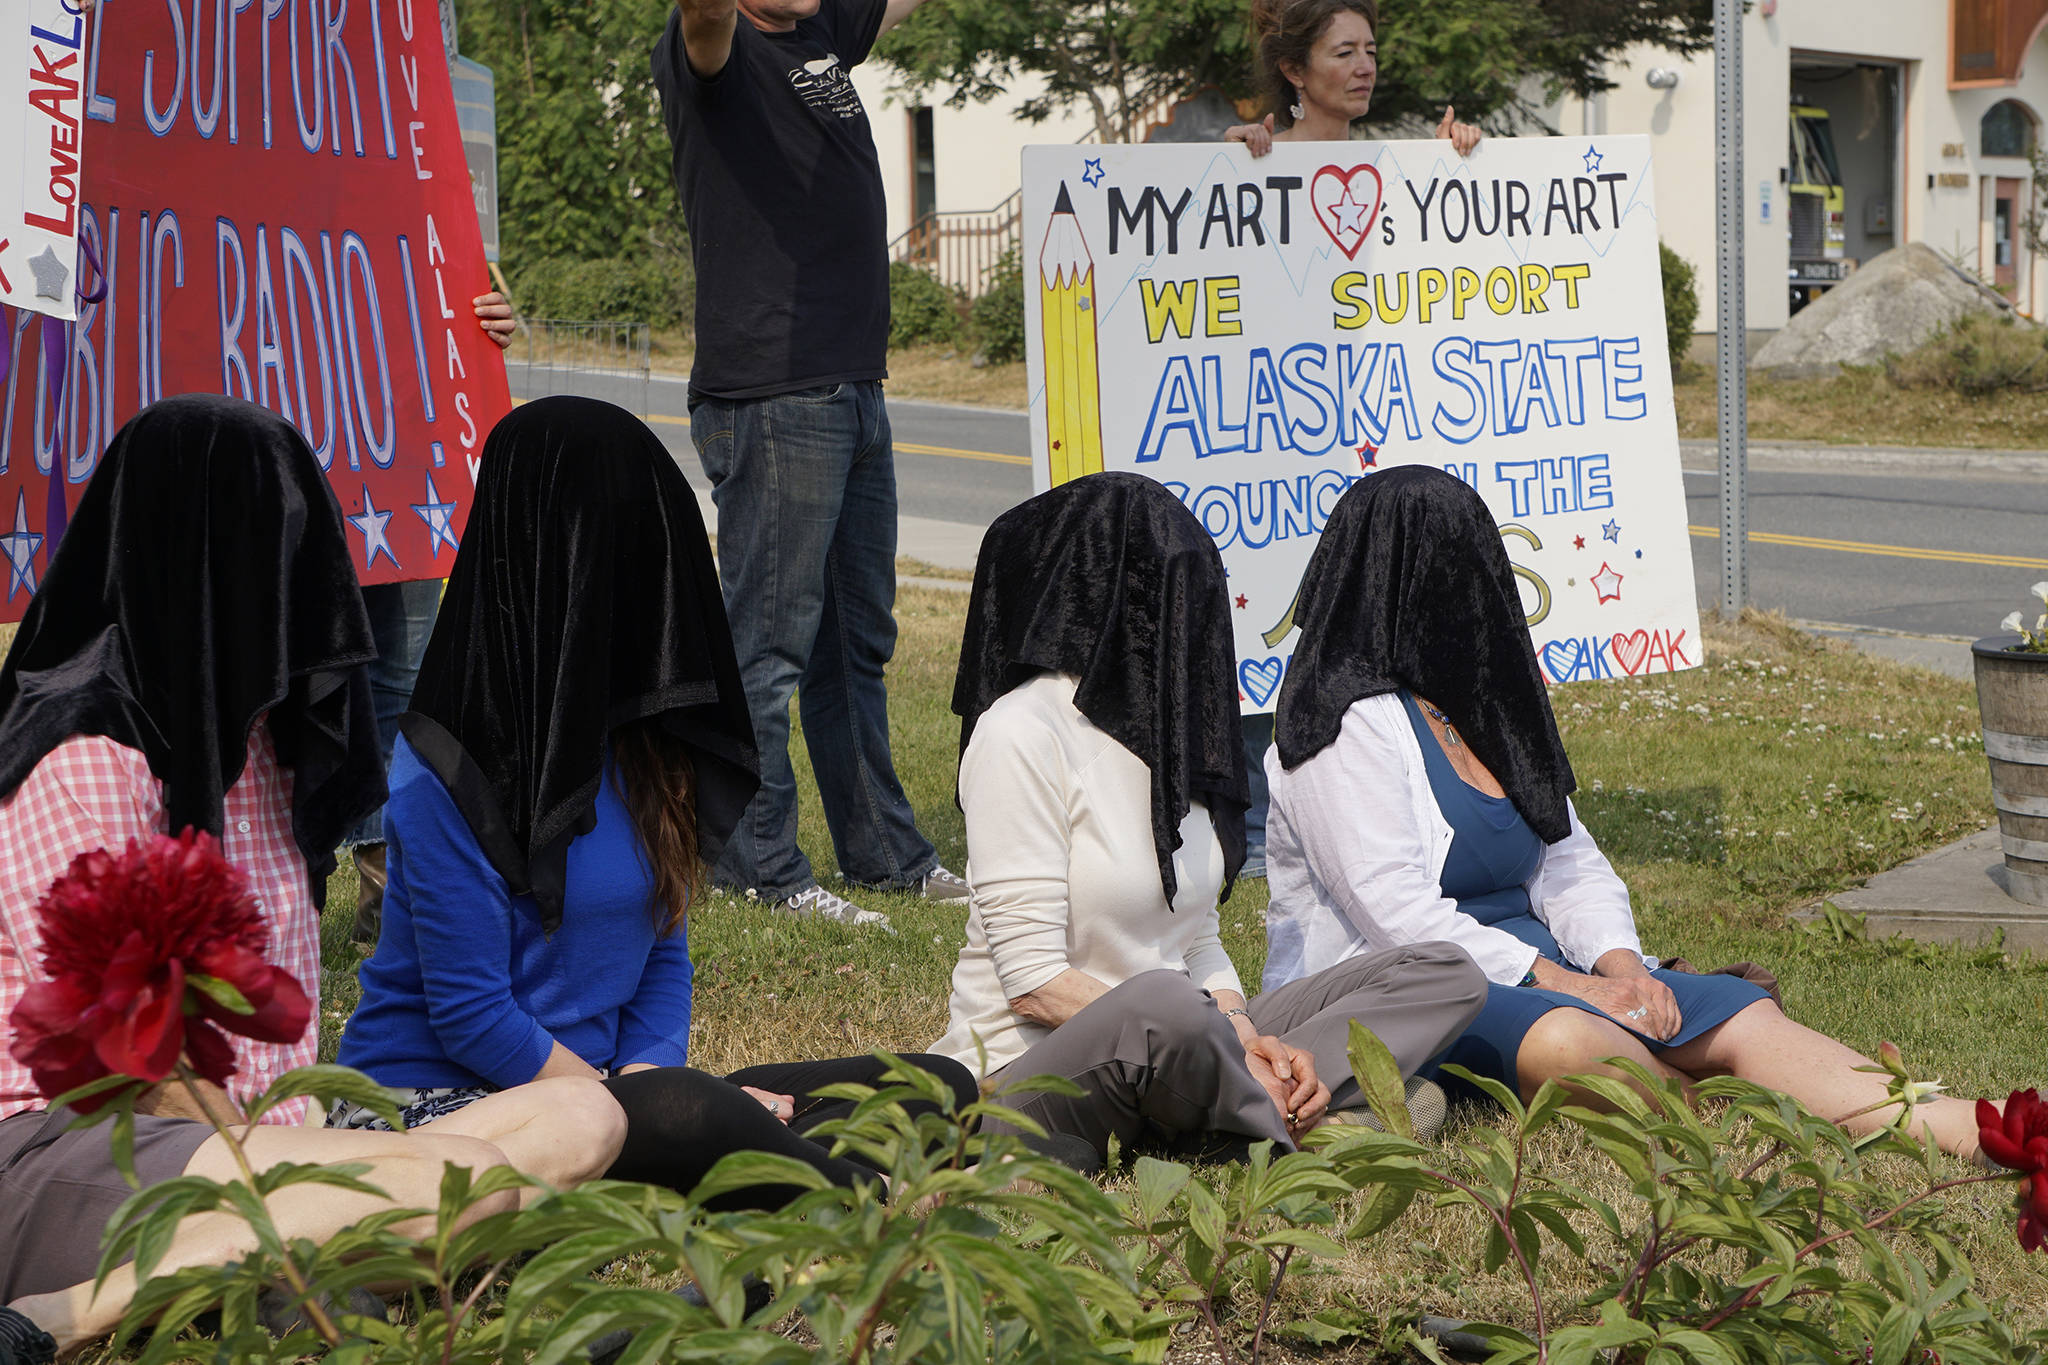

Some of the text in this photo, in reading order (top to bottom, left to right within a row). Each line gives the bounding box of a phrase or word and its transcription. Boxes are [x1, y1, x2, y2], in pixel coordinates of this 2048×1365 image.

[1107, 186, 1193, 256] MY
[1199, 176, 1303, 250] ART
[1405, 177, 1532, 243] YOUR
[1543, 172, 1628, 237] ART
[1138, 263, 1591, 344] WE SUPPORT
[1135, 335, 1648, 464] ALASKA STATE
[1162, 453, 1615, 551] OUNC THE
